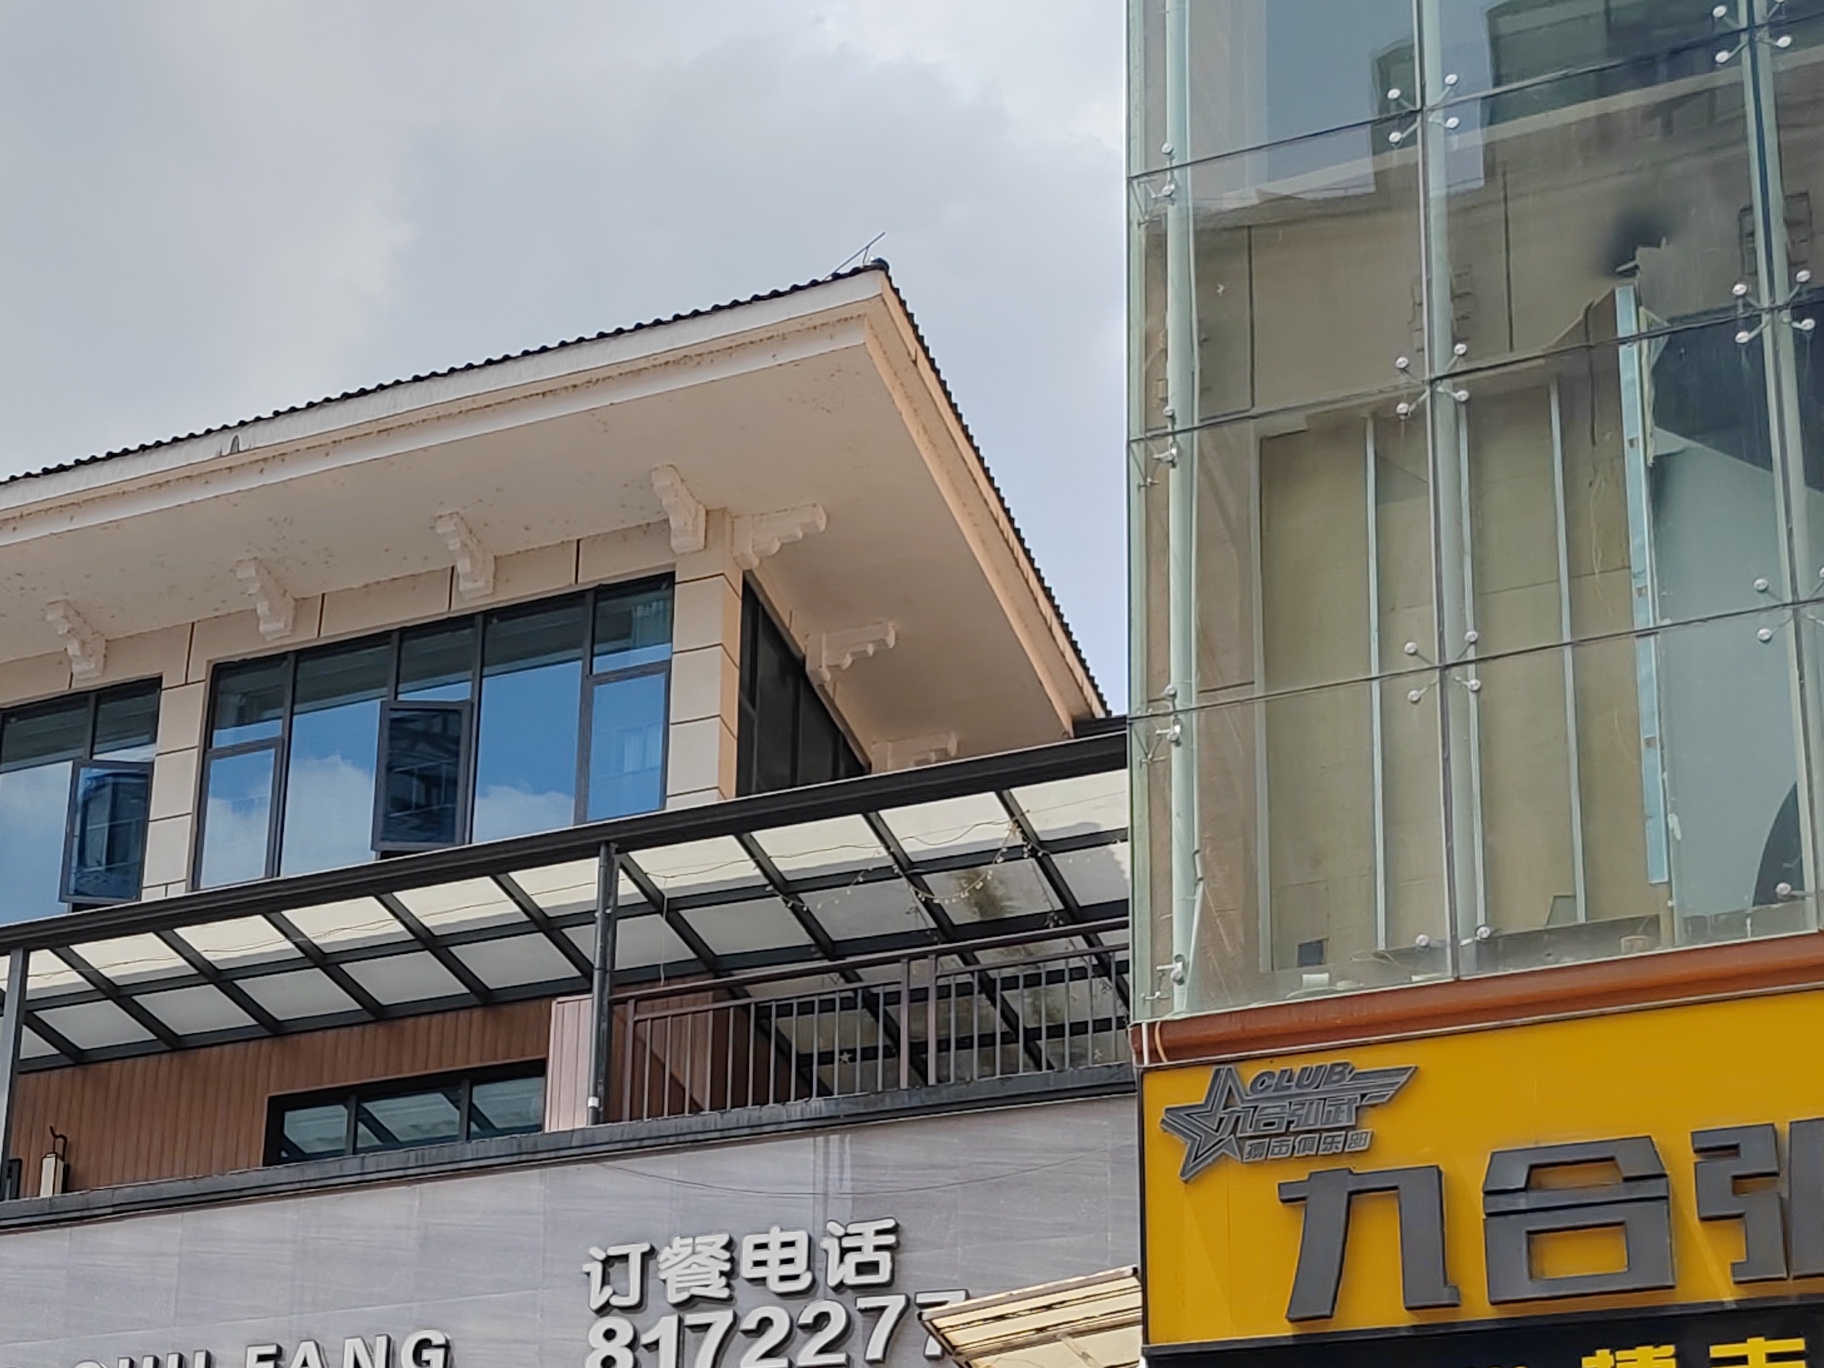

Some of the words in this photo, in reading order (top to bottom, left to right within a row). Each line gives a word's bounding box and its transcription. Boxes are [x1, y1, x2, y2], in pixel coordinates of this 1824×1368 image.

[1249, 1061, 1354, 1093] CLUB
[582, 1217, 899, 1312] 订餐电话
